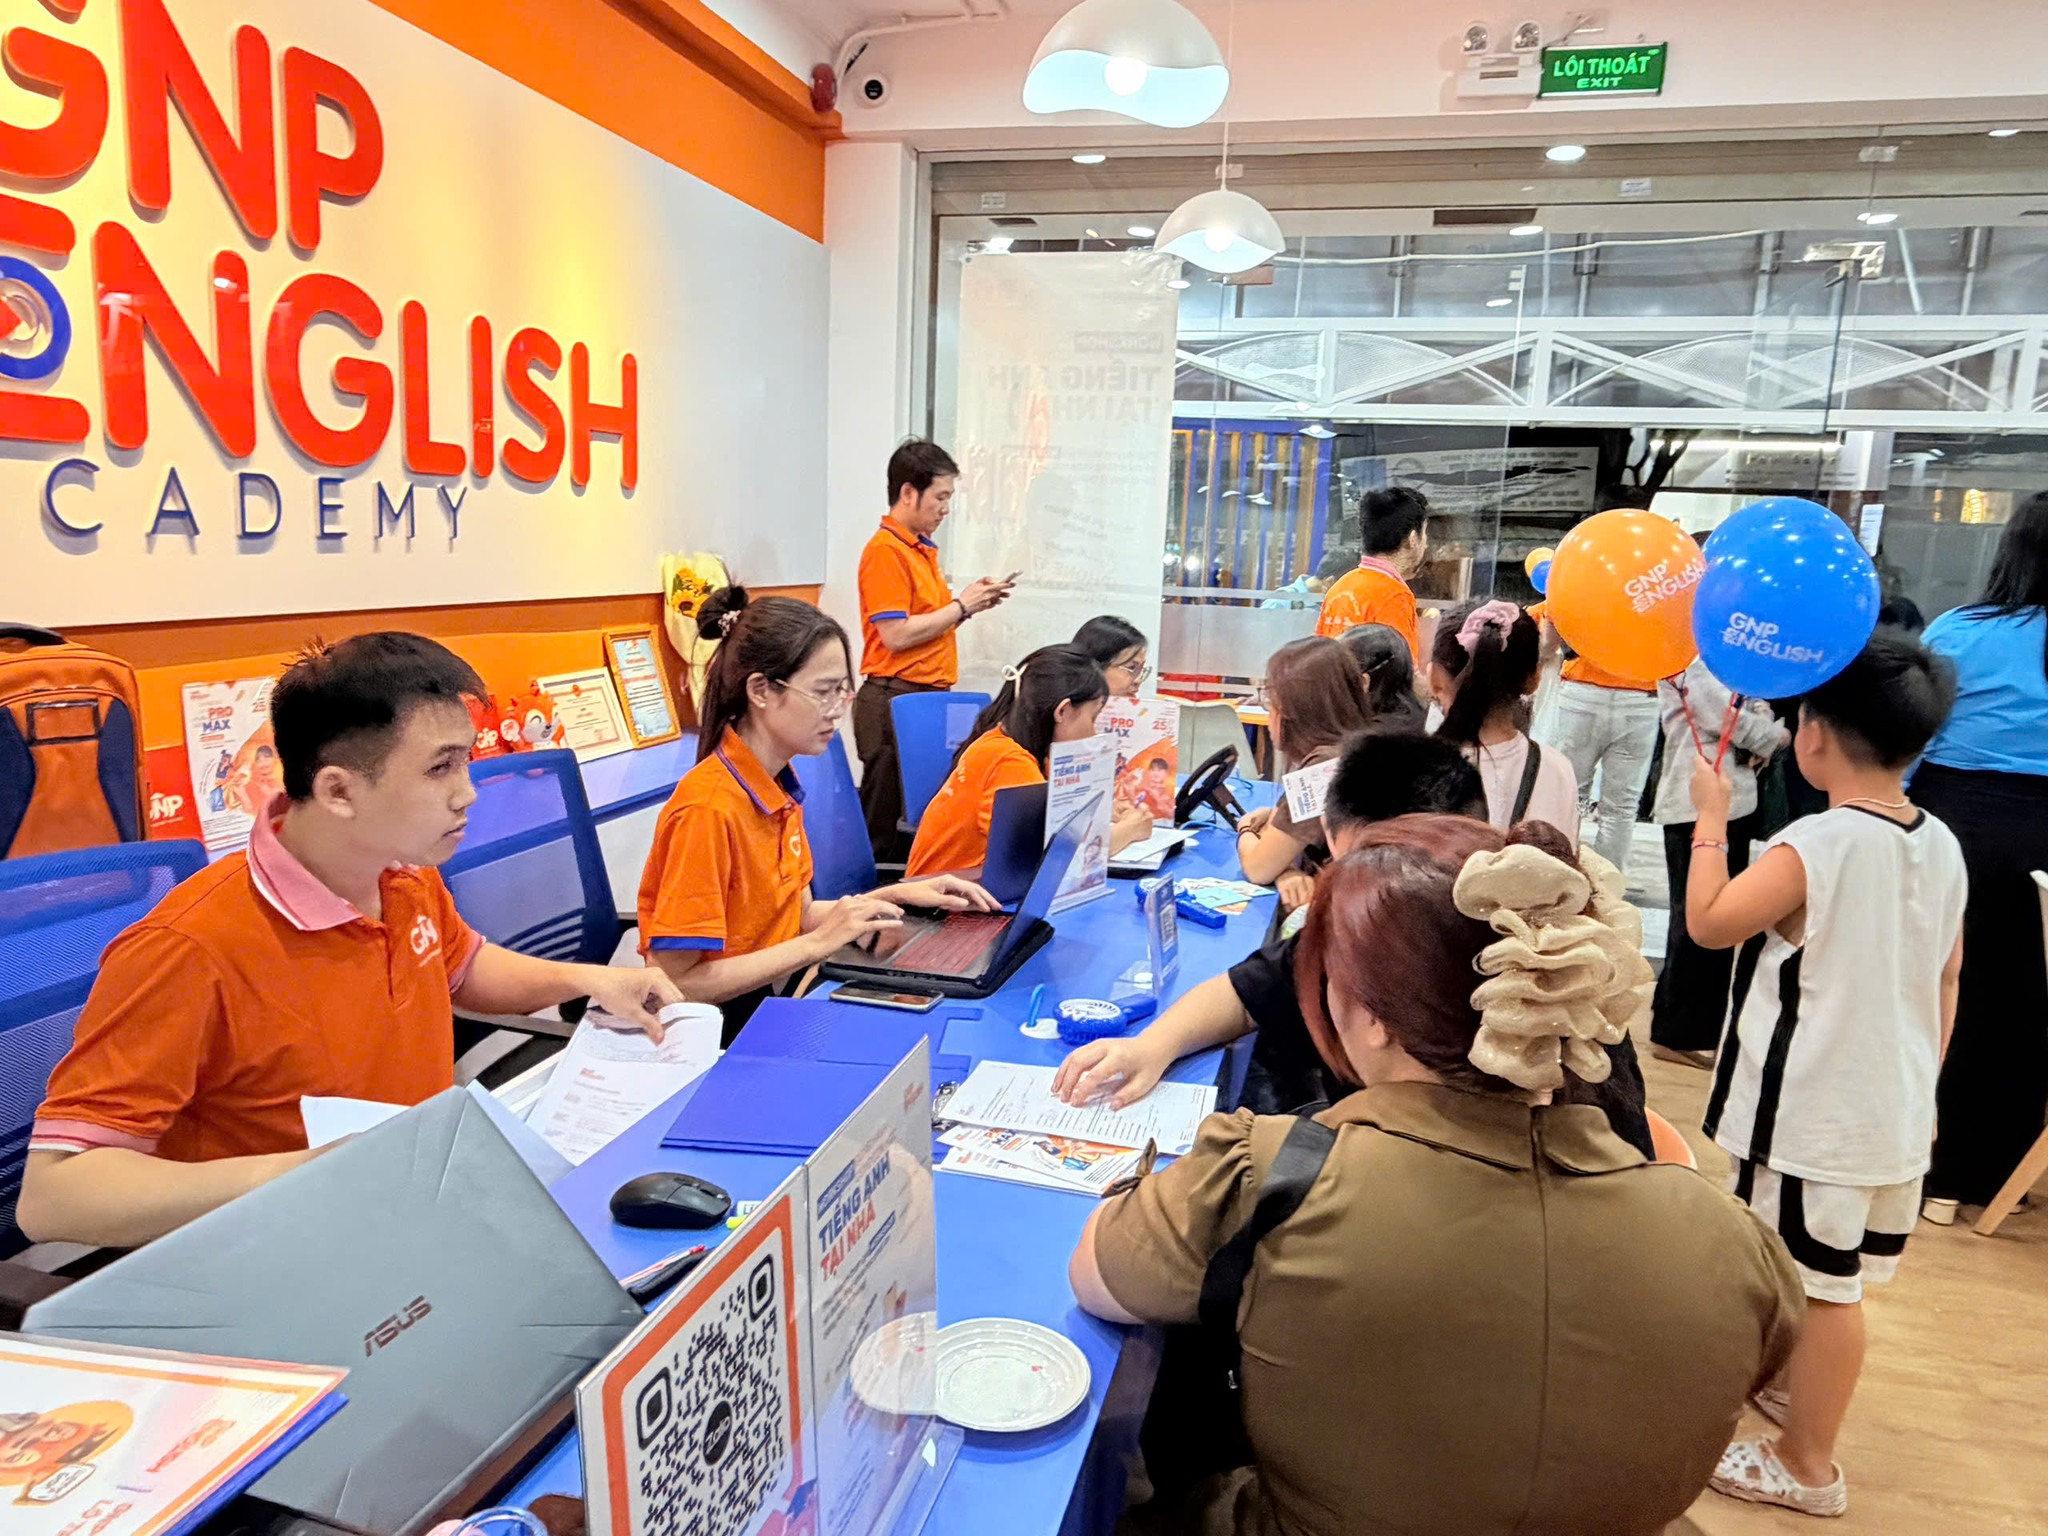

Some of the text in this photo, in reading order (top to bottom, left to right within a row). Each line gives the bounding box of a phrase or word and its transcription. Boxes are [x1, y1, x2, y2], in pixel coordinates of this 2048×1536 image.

[1587, 52, 1651, 75] THOÁT
[1577, 77, 1623, 88] EXIT
[1625, 564, 1668, 597] GNP
[1632, 559, 1707, 613] ENGLISH
[1729, 612, 1779, 637] GNP
[1720, 627, 1824, 663] ENGLISH
[203, 719, 232, 732] MAX
[208, 706, 234, 720] PRO
[1110, 717, 1134, 728] PRO
[864, 1150, 890, 1202] ANH
[364, 1295, 432, 1357] ASUS
[705, 1415, 730, 1455] Zalo
